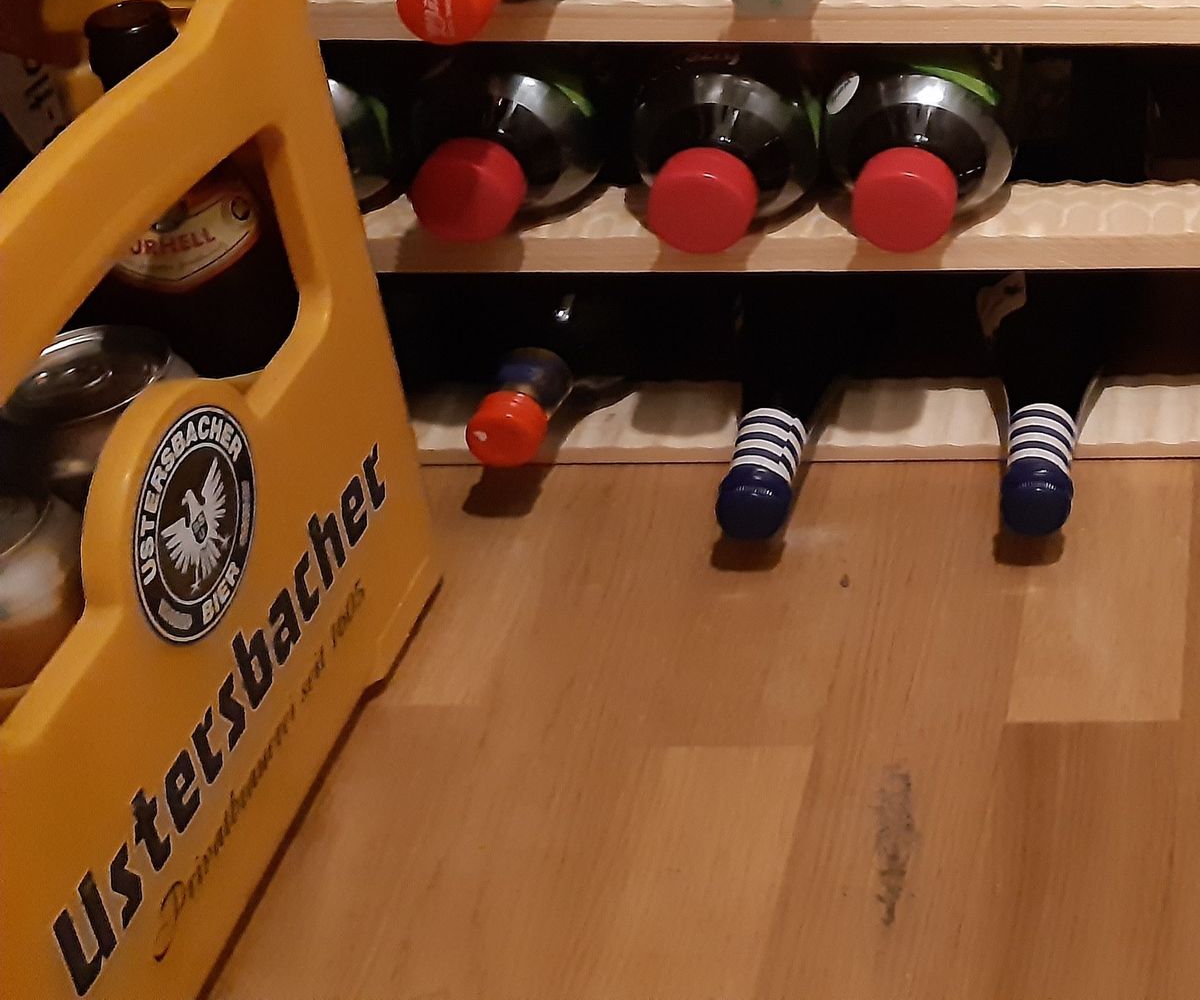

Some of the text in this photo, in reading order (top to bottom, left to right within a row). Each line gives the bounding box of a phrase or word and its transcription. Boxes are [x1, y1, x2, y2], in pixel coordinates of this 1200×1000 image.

[140, 415, 243, 586] USTERSBACHER
[201, 561, 240, 625] BIER
[52, 443, 388, 998] Ustersbacher
